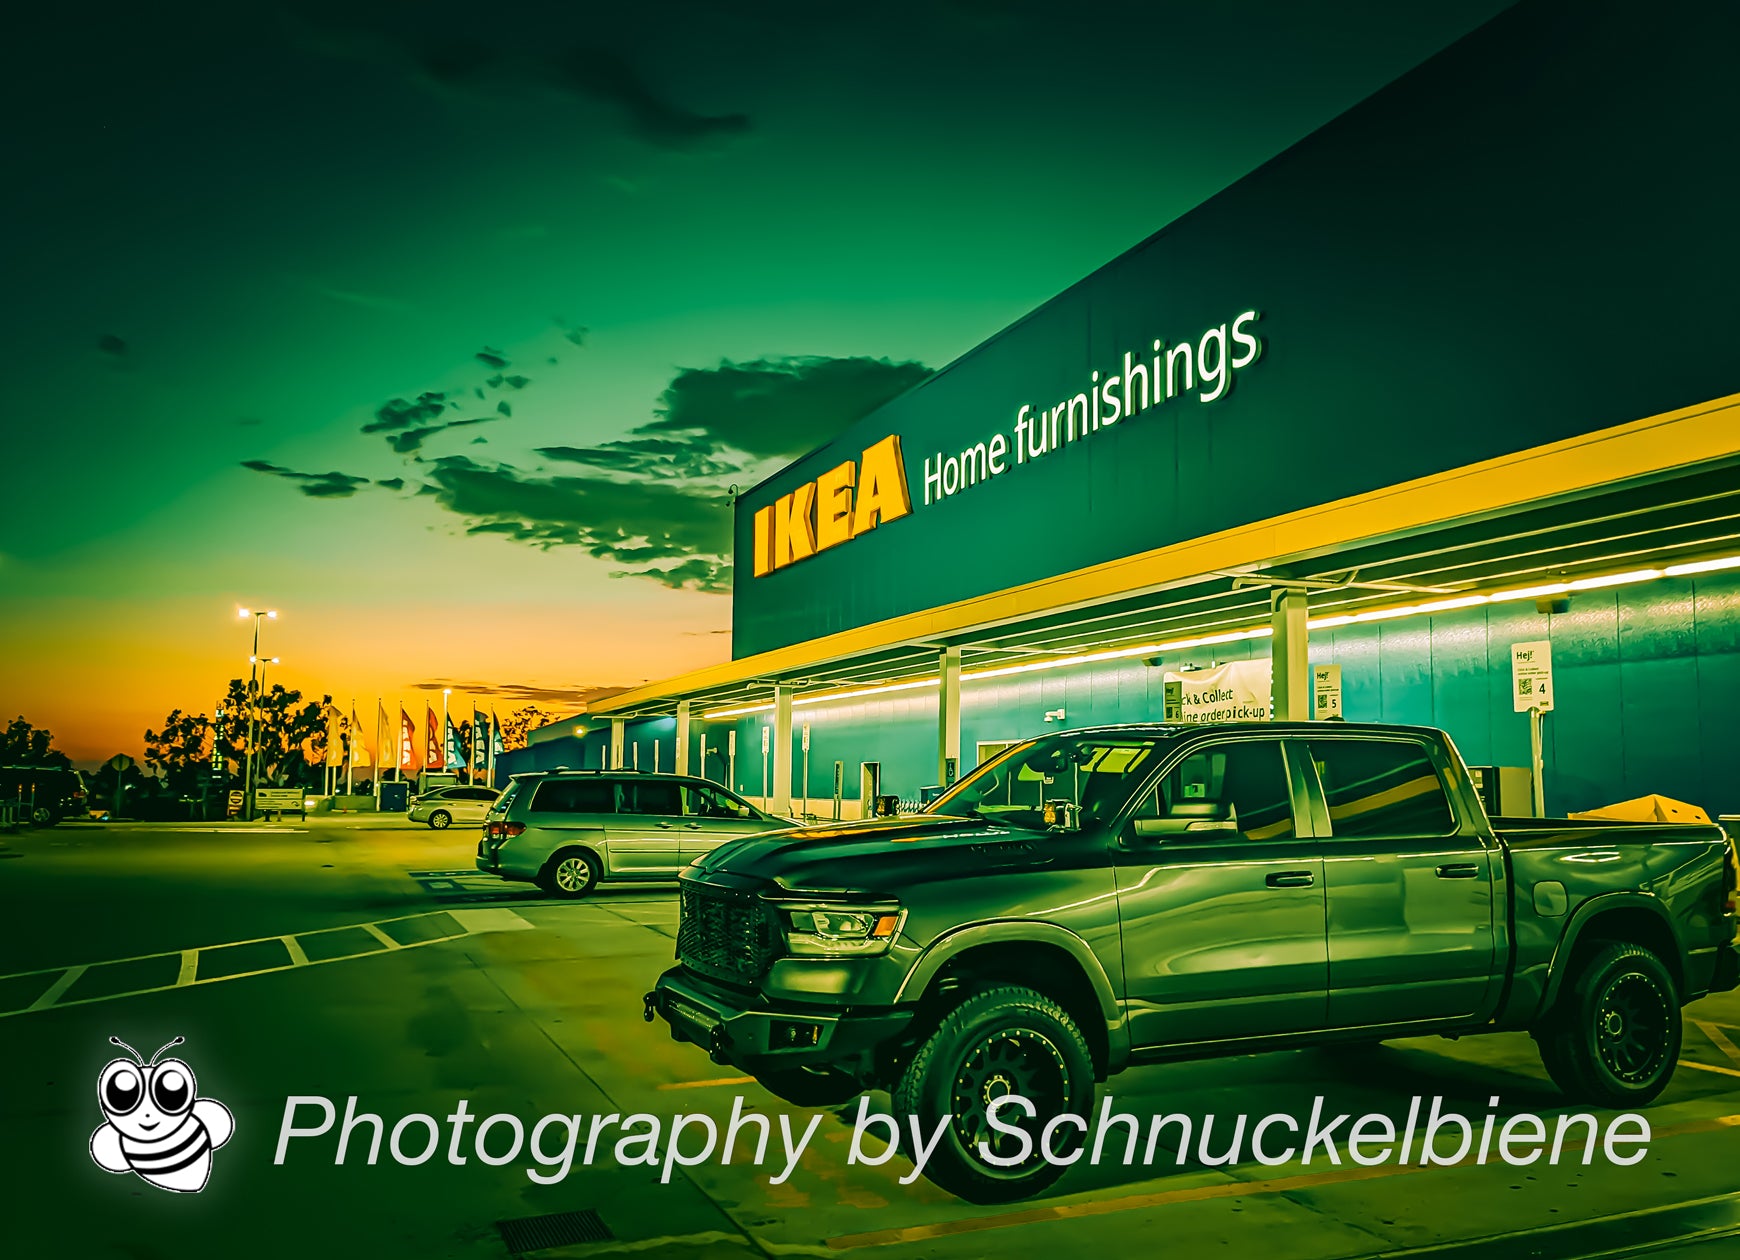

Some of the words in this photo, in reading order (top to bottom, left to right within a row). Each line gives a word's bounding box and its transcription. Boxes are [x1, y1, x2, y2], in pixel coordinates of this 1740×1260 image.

[924, 434, 1006, 506] Home
[1013, 310, 1258, 464] furnishings
[753, 434, 912, 578] IKEA
[1516, 650, 1533, 661] Hej!
[1202, 688, 1234, 704] Collect
[1538, 683, 1546, 695] 4
[1331, 698, 1337, 709] 5
